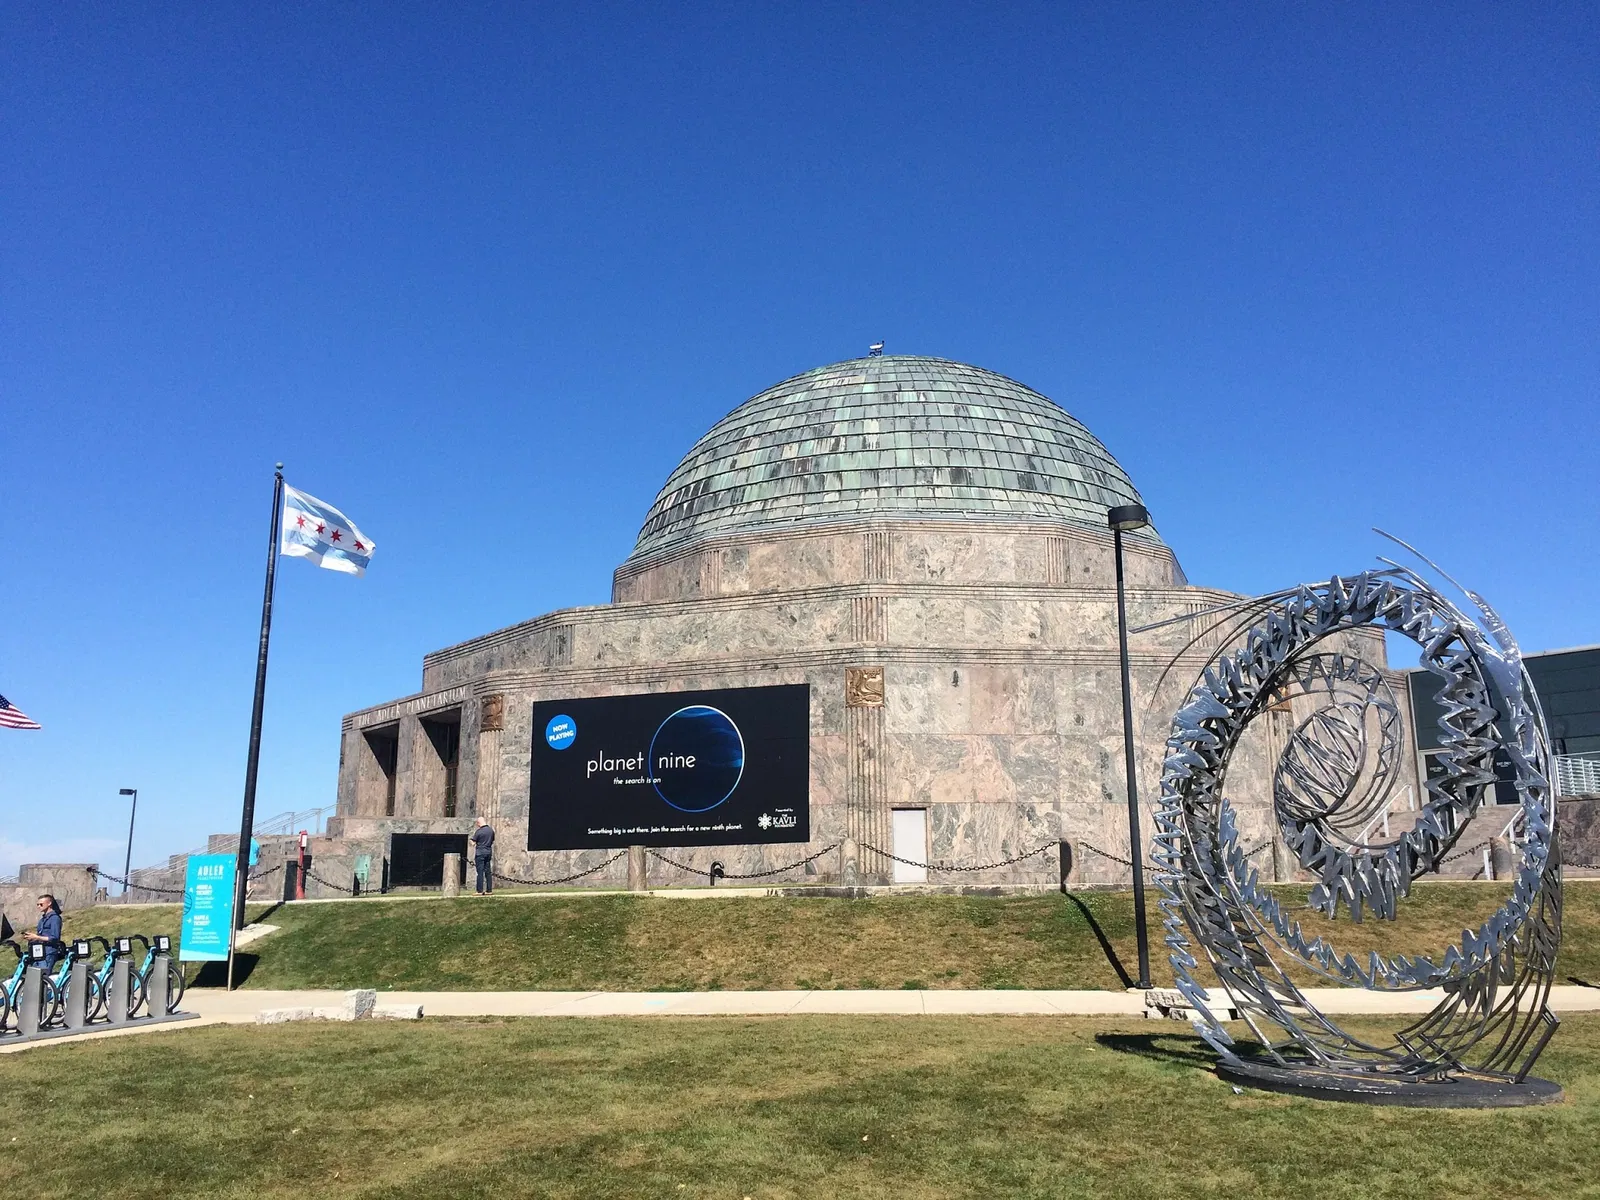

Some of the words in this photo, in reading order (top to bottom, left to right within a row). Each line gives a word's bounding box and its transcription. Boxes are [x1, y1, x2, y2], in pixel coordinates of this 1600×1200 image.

[358, 713, 371, 727] THE
[377, 703, 401, 722] ADLER
[406, 687, 467, 714] PLANETARIUM
[552, 723, 569, 733] NOW
[549, 730, 575, 742] PLAYING
[587, 750, 644, 779] planet
[658, 752, 696, 769] nine
[613, 777, 624, 785] the
[625, 776, 645, 785] search
[773, 816, 797, 825] KAVLI
[588, 827, 613, 836] Something
[198, 865, 224, 877] ADLER
